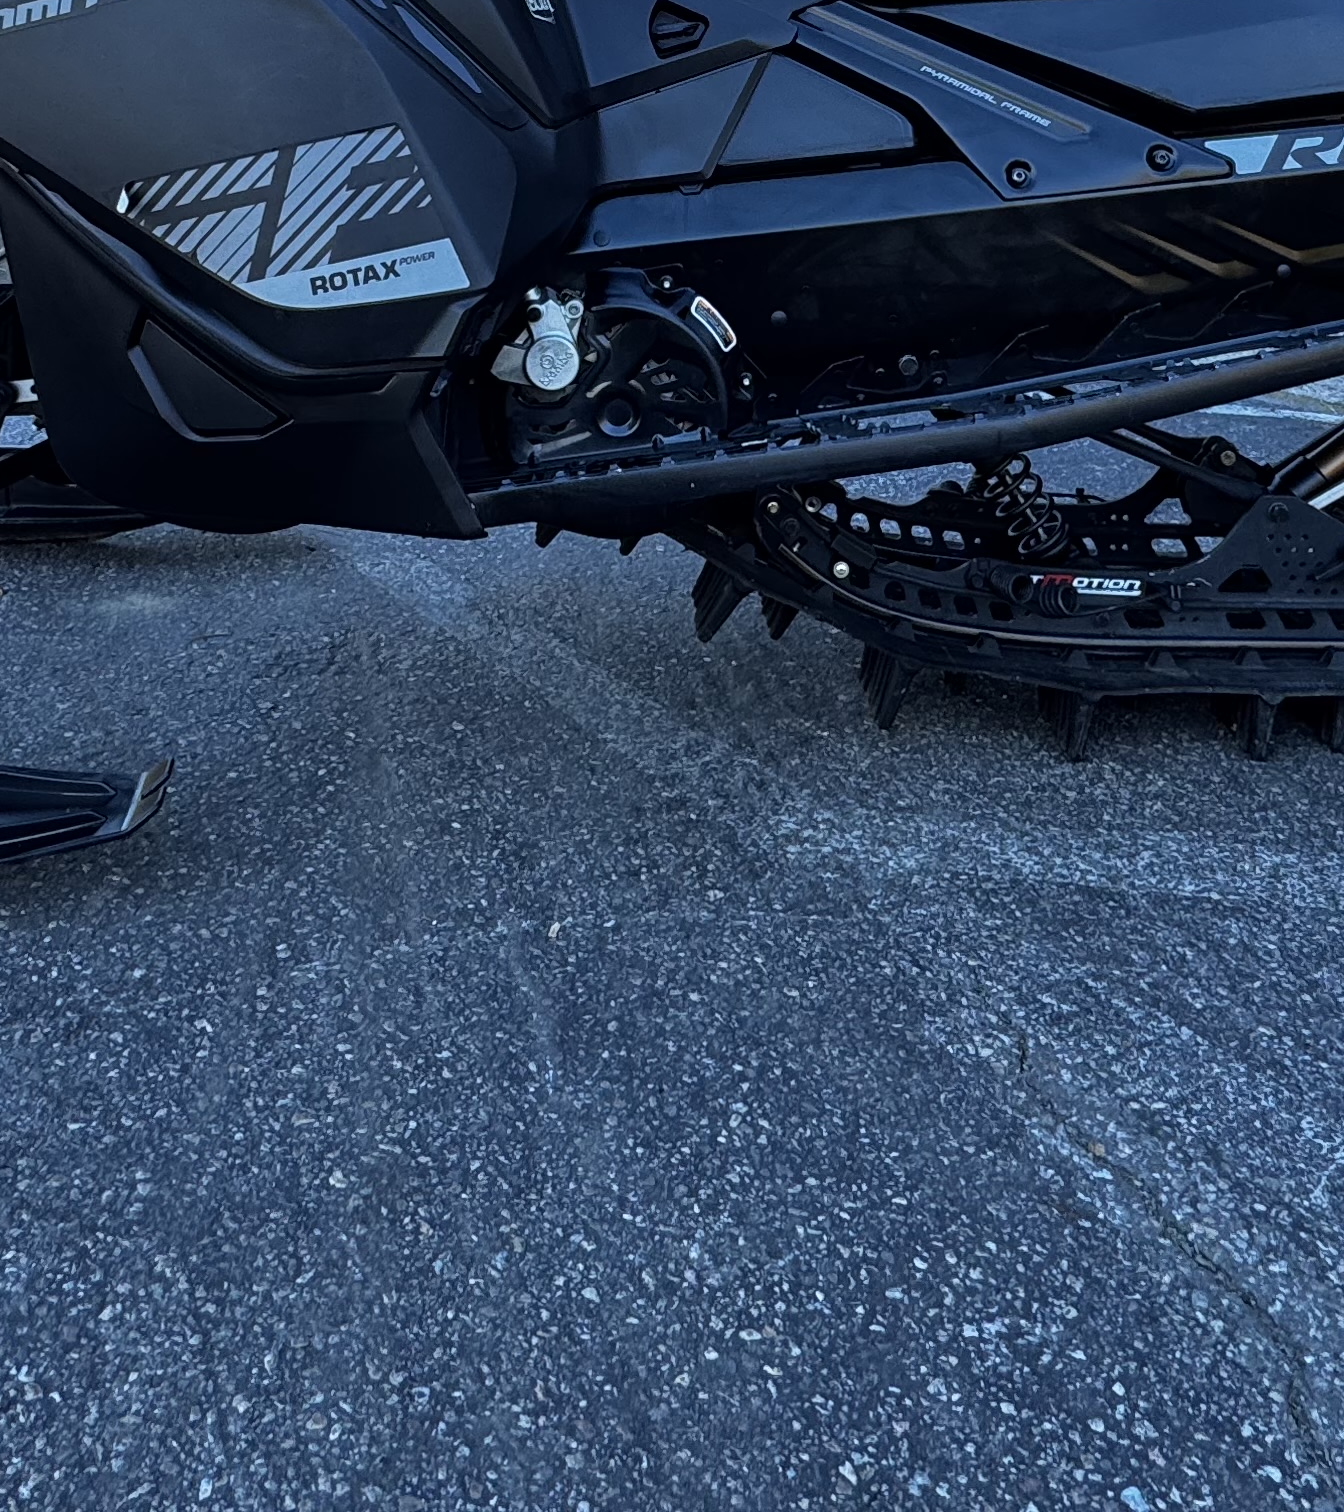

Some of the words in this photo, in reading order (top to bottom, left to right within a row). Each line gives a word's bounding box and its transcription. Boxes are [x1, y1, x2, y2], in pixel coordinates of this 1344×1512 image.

[920, 65, 997, 105] PYRAMIDAL
[1000, 101, 1052, 127] FRAME
[310, 259, 401, 296] ROTAX
[399, 251, 436, 266] POWER
